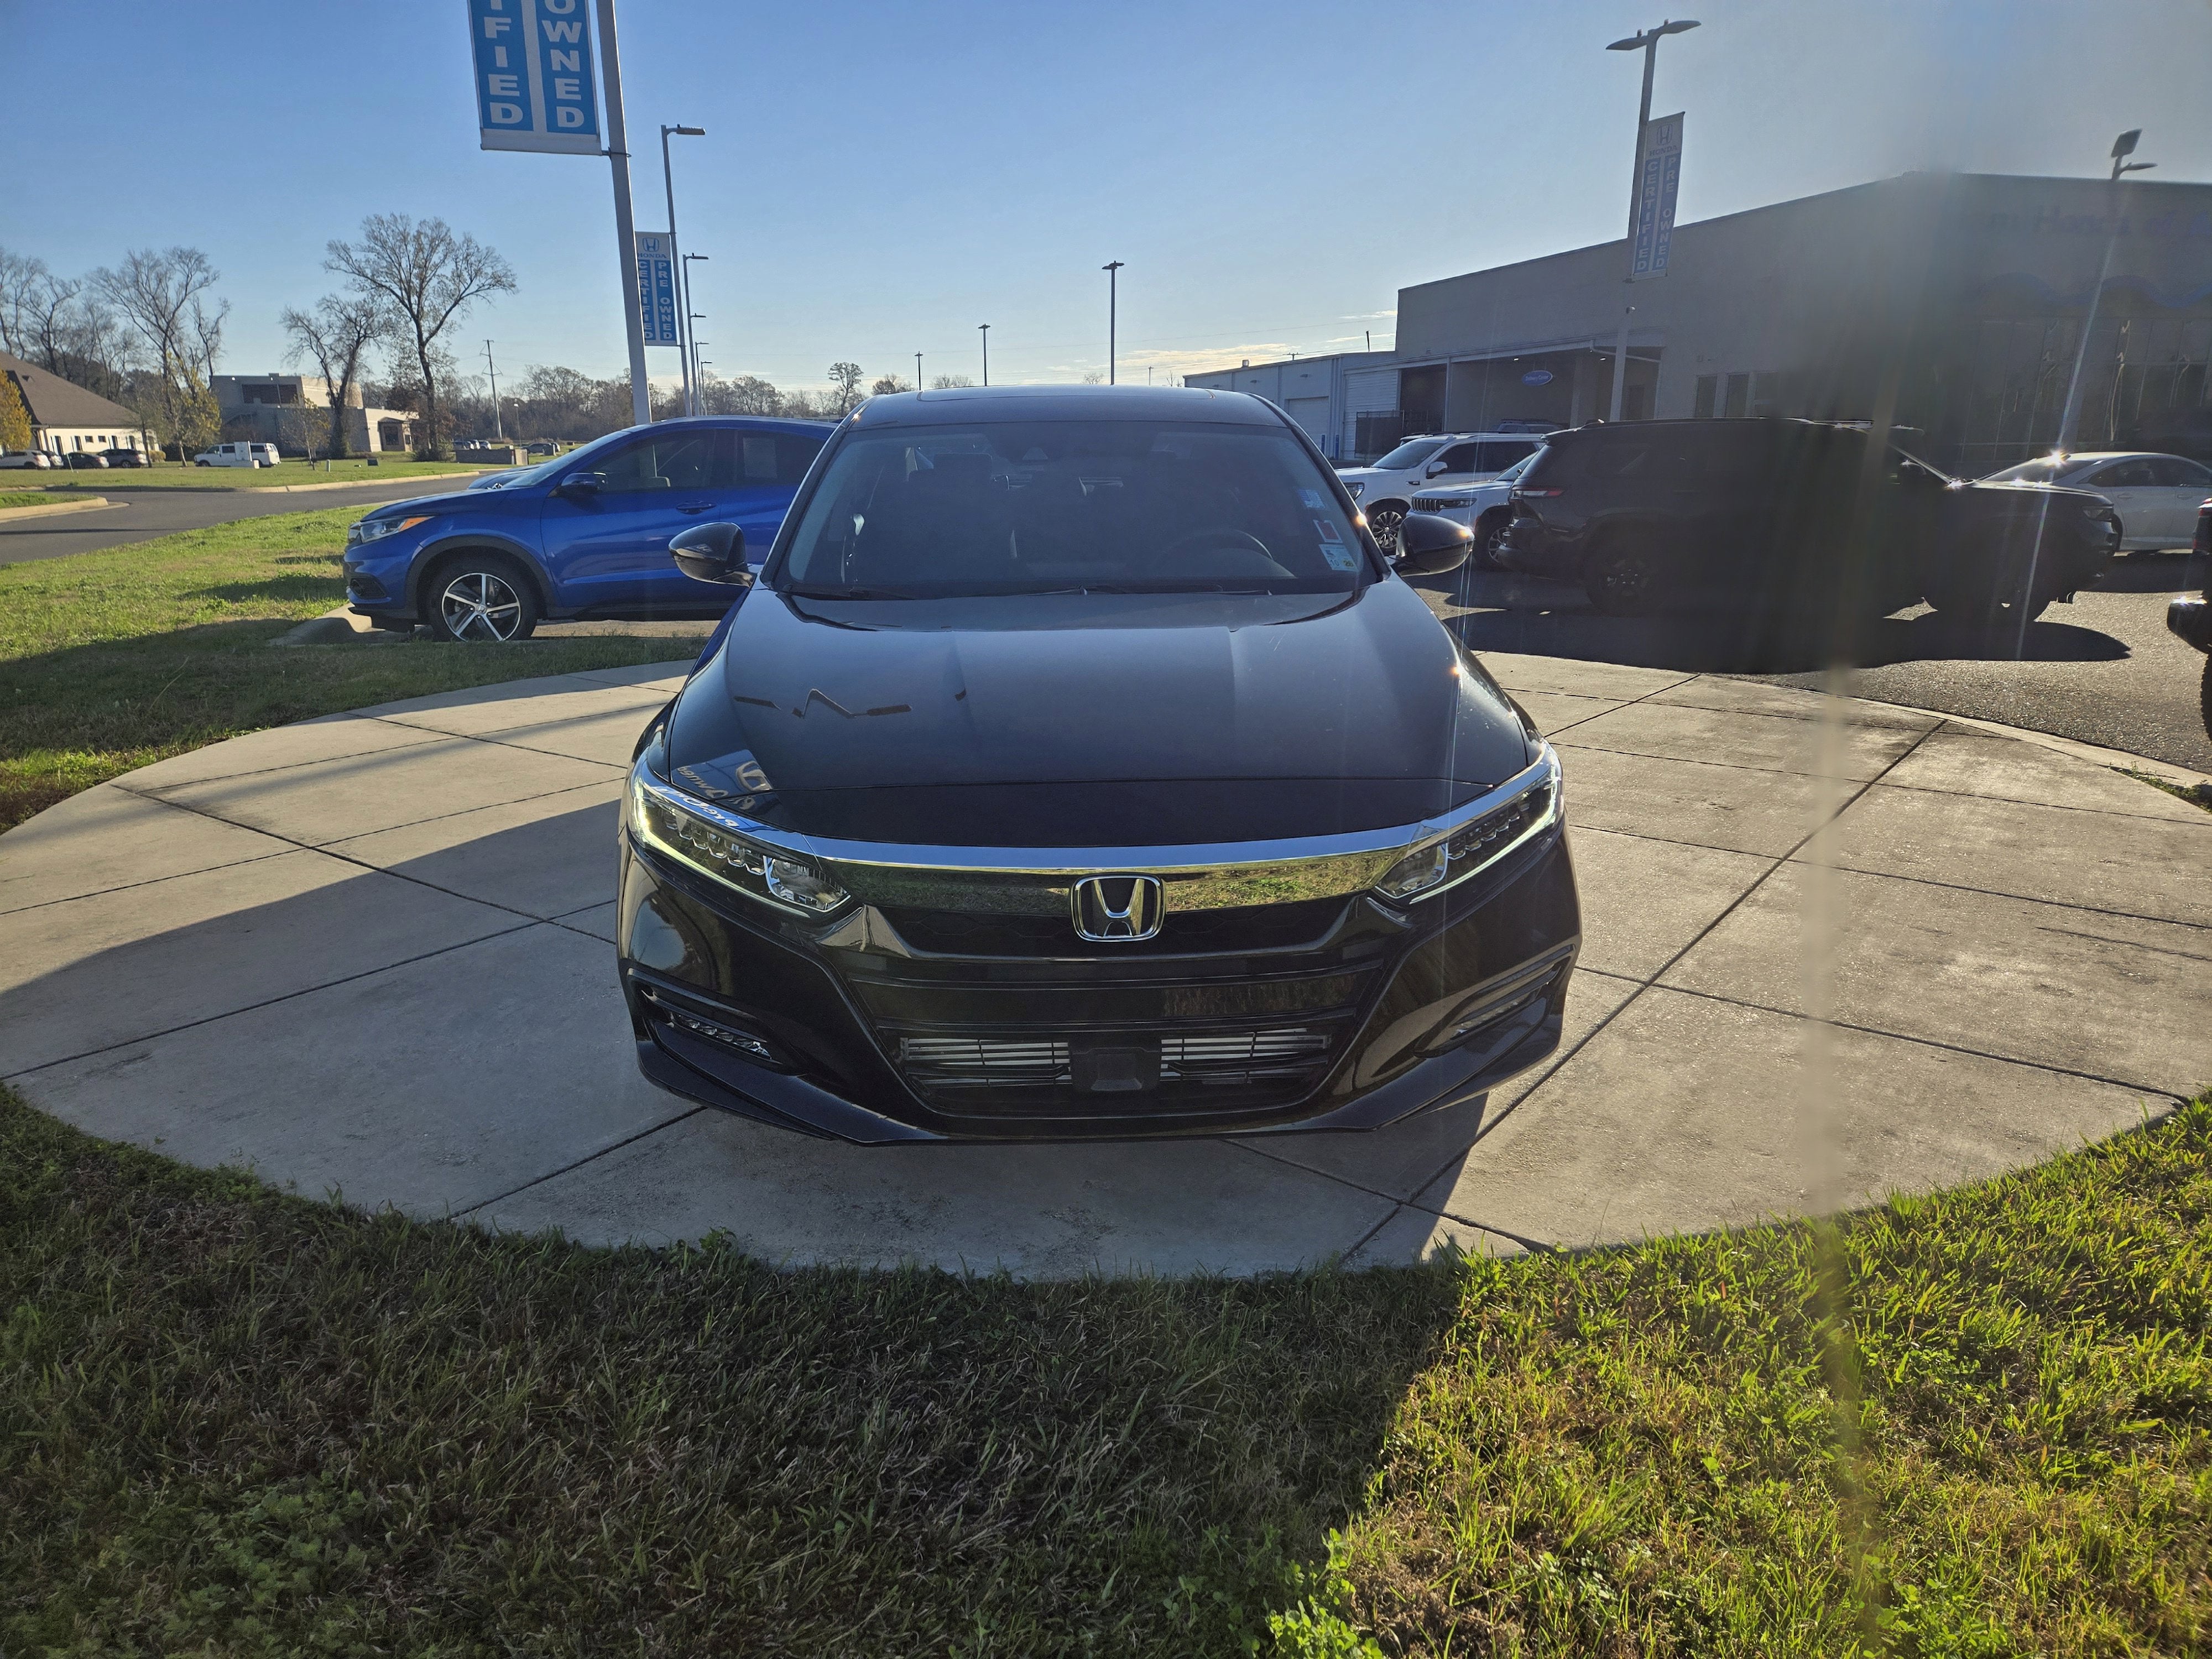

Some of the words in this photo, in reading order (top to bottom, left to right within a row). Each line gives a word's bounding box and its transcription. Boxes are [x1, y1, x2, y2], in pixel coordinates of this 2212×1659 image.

[542, 0, 584, 127] OWNED
[1648, 145, 1677, 156] HONDA
[1666, 157, 1676, 192] PRE
[1637, 161, 1658, 271] CERTIFIED
[1656, 208, 1672, 268] OWNED
[638, 261, 654, 338] CERTIFIED
[658, 262, 668, 287] PRE
[659, 297, 672, 339] OWNED
